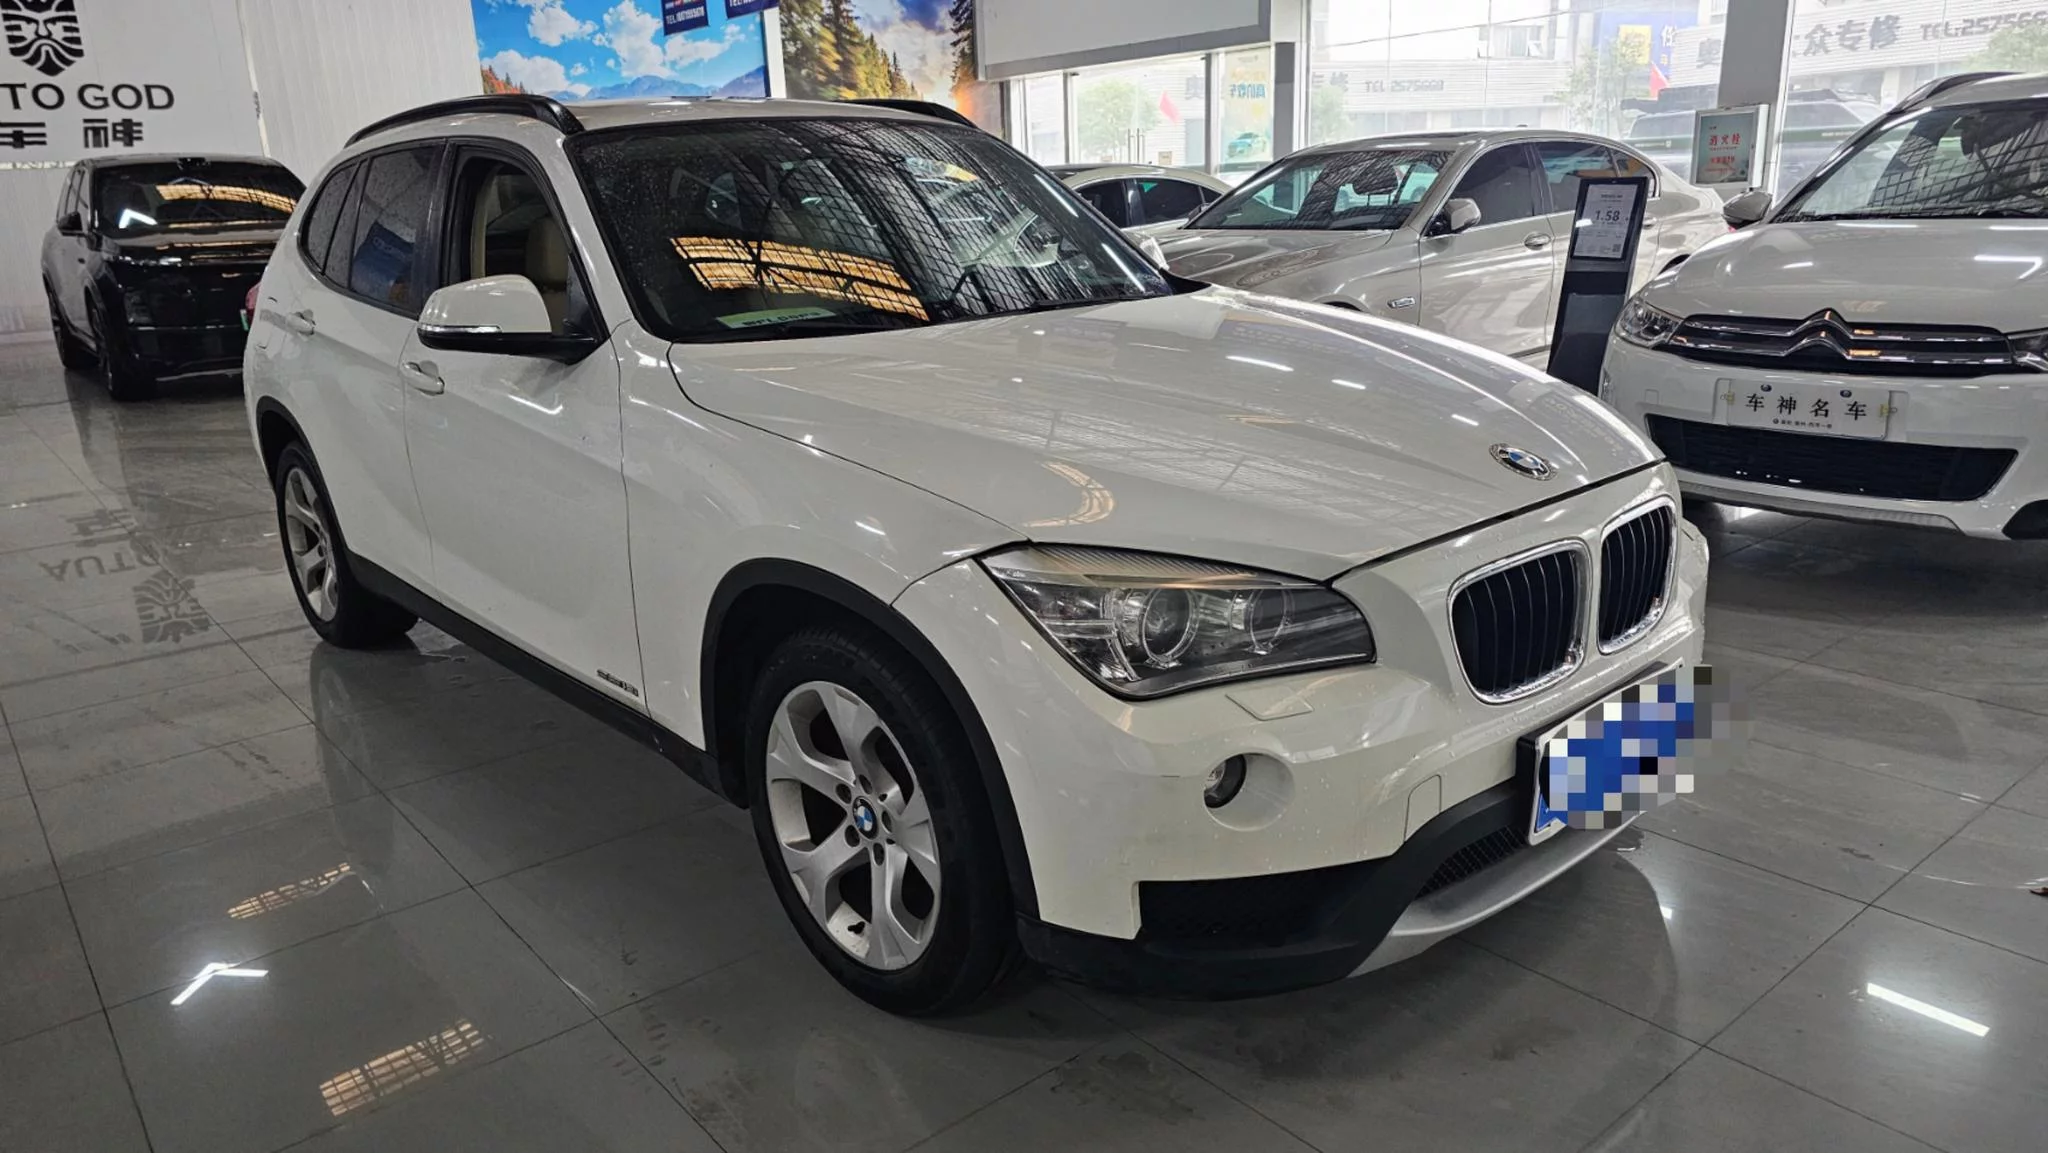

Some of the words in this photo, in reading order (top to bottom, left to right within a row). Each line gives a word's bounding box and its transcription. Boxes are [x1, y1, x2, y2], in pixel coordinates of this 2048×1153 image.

[77, 83, 174, 111] GOD
[1595, 210, 1621, 222] 1.58
[1745, 393, 1867, 421] 车神名车
